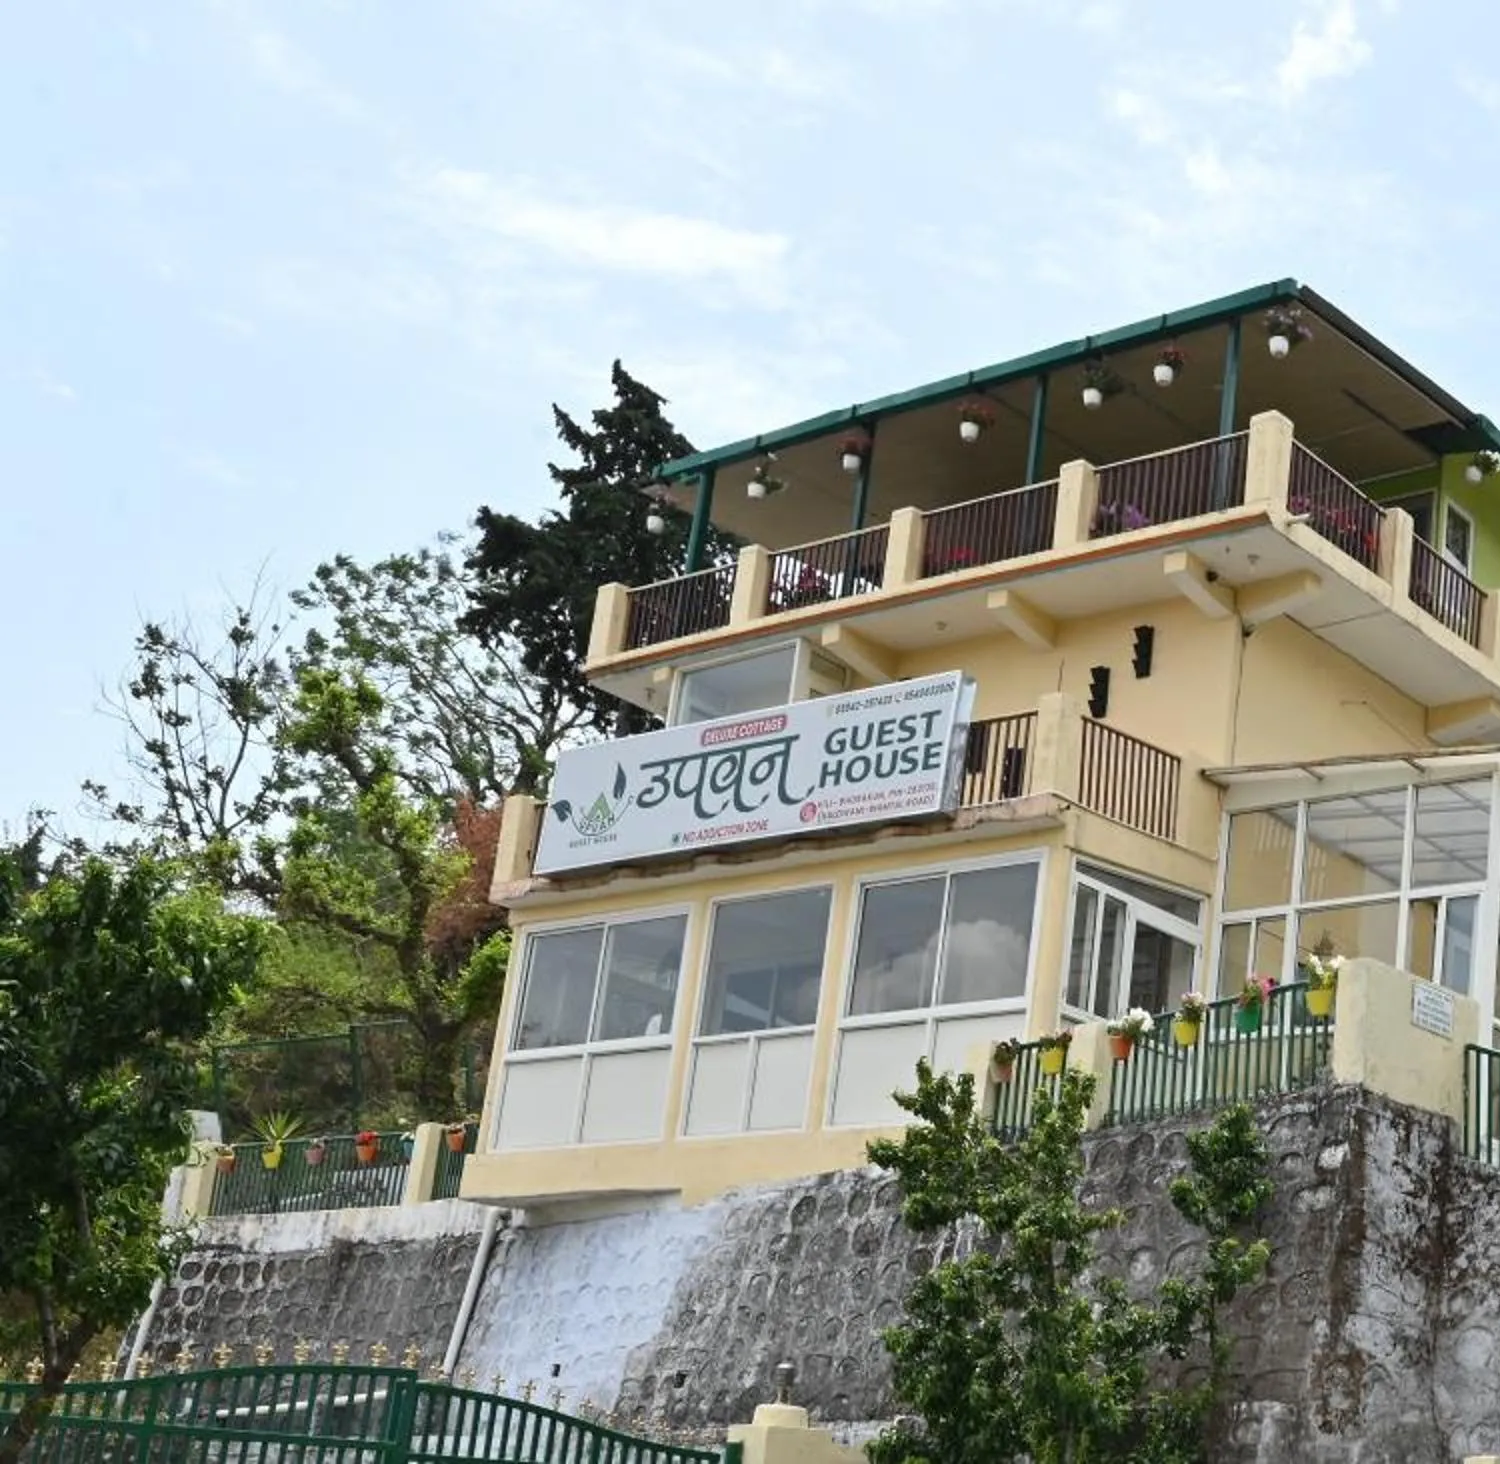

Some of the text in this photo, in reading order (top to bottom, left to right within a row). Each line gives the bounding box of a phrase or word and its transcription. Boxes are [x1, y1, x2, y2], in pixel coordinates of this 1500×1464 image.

[703, 717, 784, 745] DELUXE COTTAGE
[823, 710, 942, 755] GUEST
[636, 733, 816, 819] उपवन
[819, 742, 944, 788] HOUSE
[682, 818, 769, 843] NO ADDICTION ZONE
